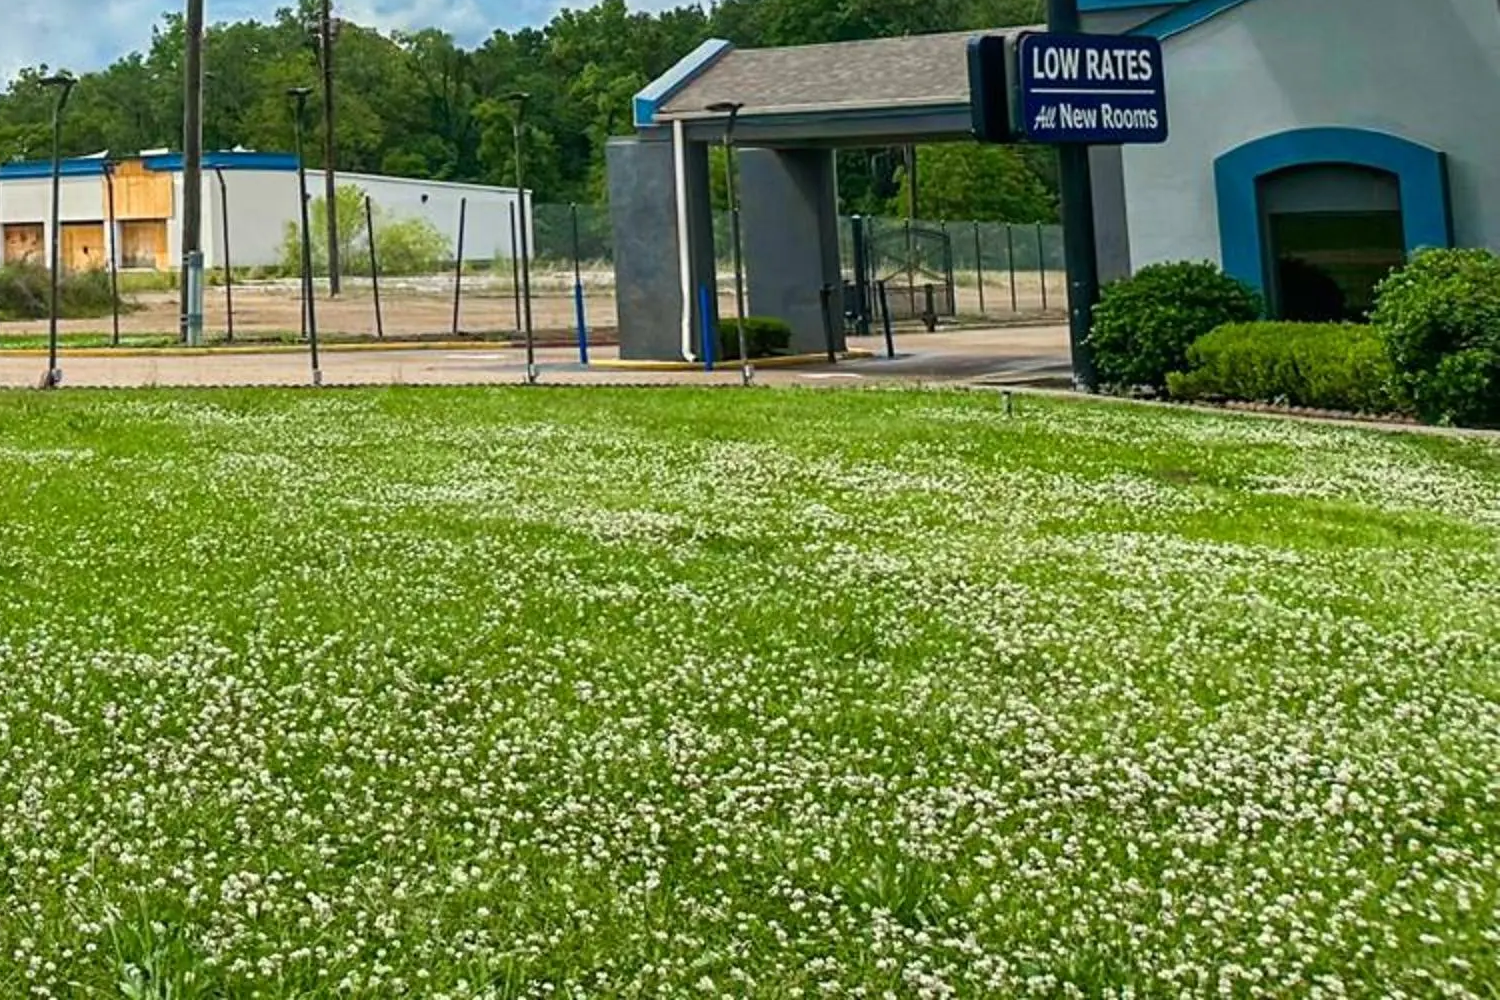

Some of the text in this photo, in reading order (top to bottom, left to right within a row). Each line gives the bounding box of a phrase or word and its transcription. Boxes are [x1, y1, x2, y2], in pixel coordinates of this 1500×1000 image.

[1032, 46, 1153, 82] LOW RATES
[1033, 102, 1159, 131] All New Rooms
